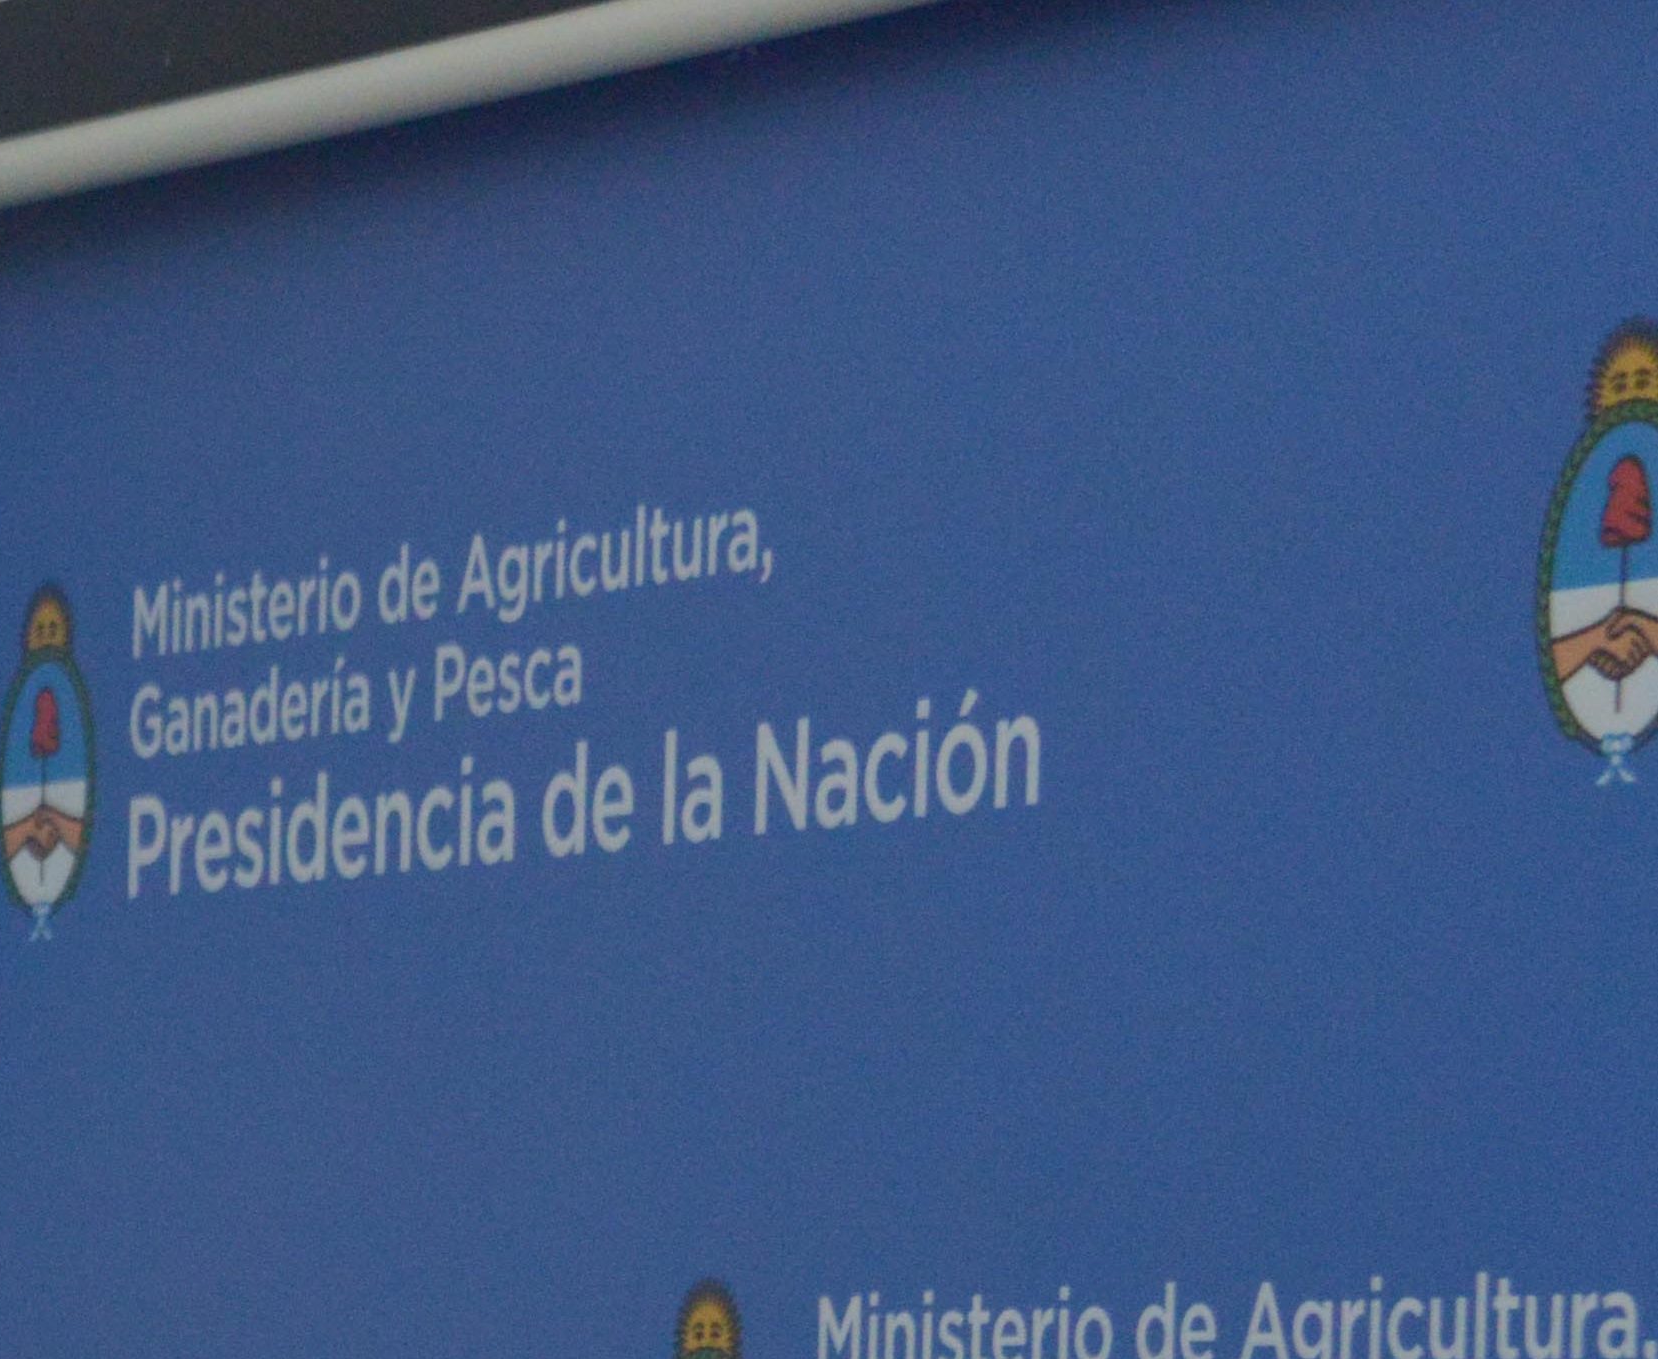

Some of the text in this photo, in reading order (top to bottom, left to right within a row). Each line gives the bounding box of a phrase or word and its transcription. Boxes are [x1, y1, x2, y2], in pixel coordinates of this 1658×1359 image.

[131, 504, 774, 658] Ministerio de Agricultura,
[129, 642, 583, 759] Ganadería y Pesca
[126, 688, 1042, 899] Presidencia de la Nación
